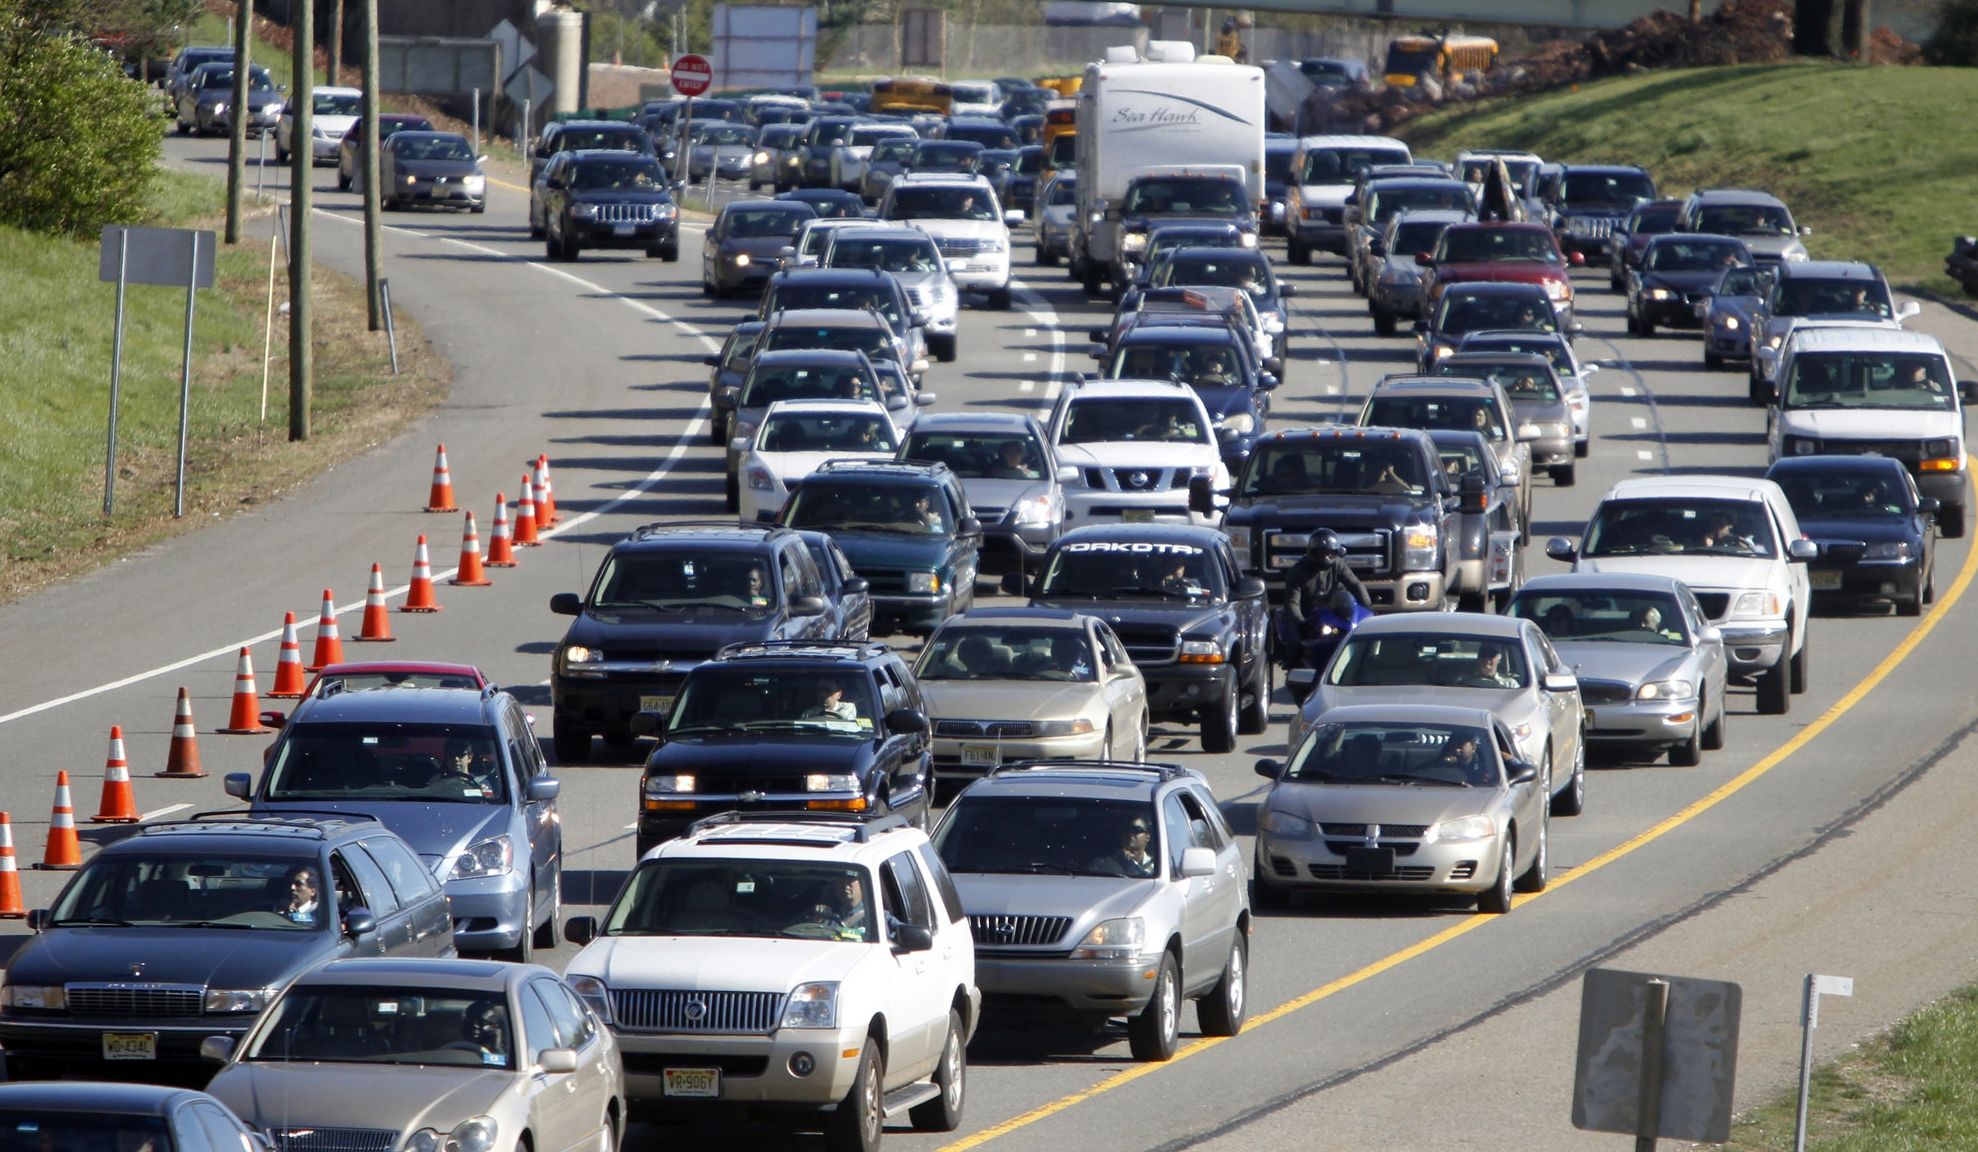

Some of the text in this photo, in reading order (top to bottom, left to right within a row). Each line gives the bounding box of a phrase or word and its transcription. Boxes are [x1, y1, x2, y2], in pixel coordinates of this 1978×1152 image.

[677, 62, 708, 71] DO NOT
[680, 80, 704, 89] ENTER
[1113, 107, 1201, 123] Sea Hawk
[1069, 542, 1194, 555] DAKOTA
